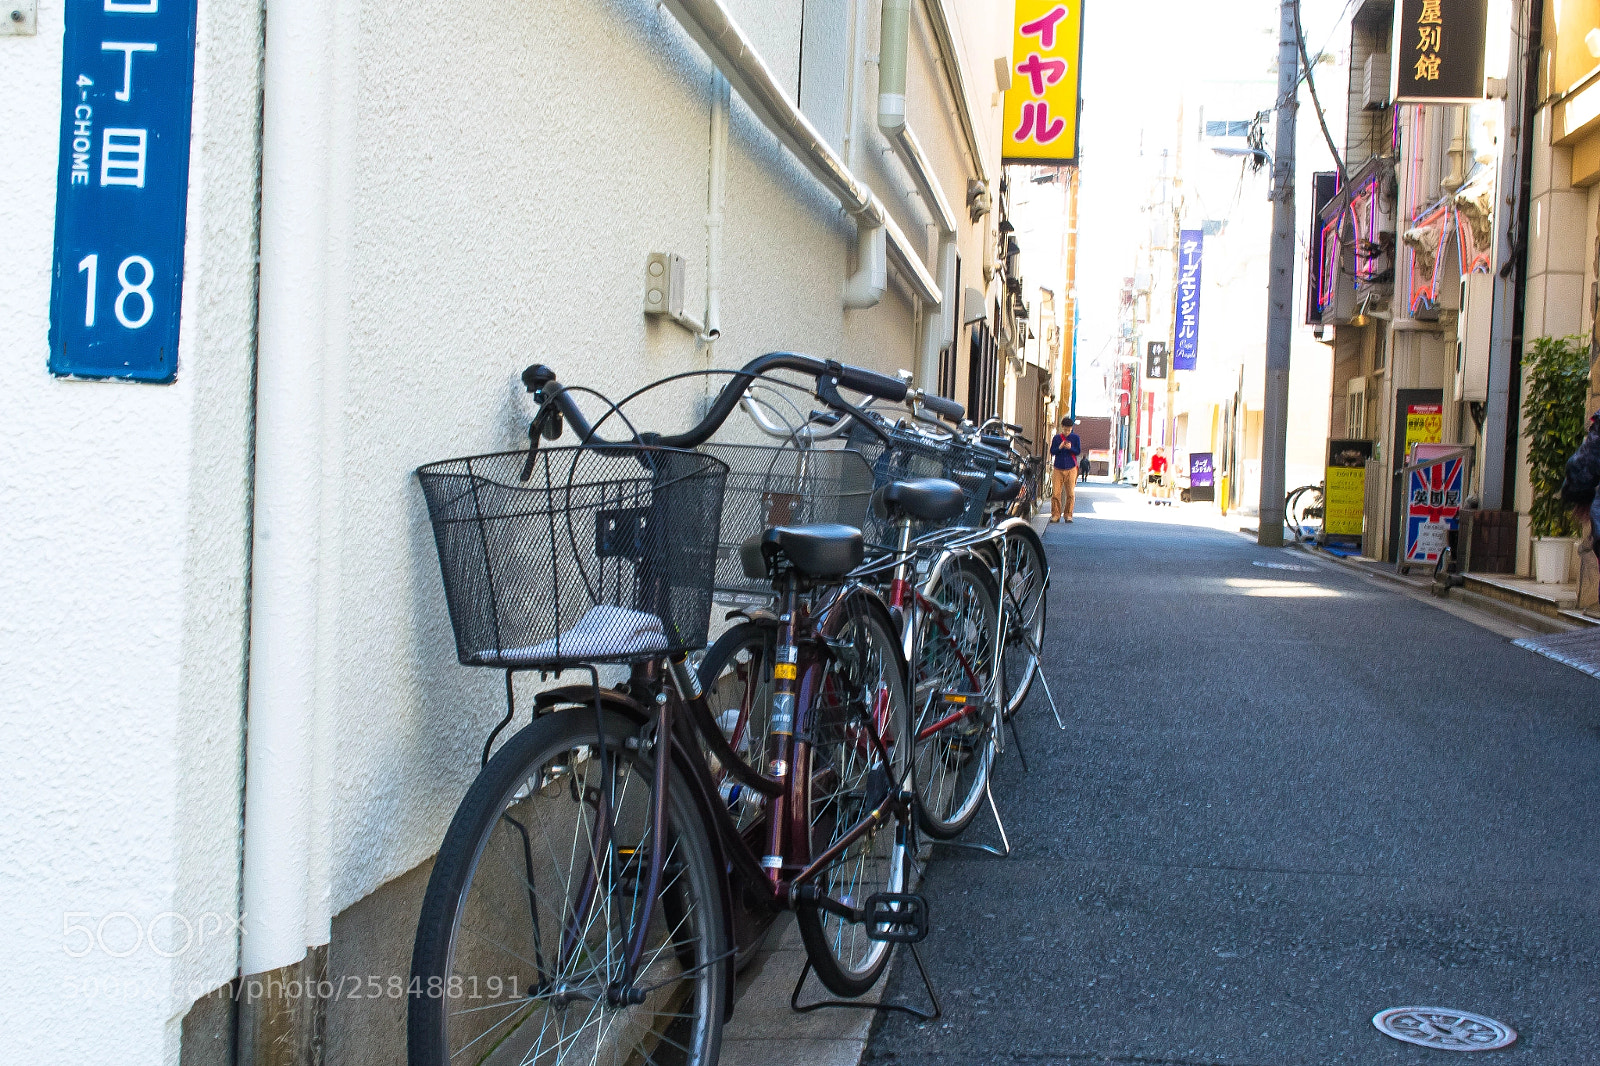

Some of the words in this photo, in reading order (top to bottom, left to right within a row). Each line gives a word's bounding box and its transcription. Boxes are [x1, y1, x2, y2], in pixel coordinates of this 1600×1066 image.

[1014, 5, 1068, 144] イヤル
[1413, 0, 1443, 81] 屋別館
[70, 73, 95, 186] 4-CHOME
[101, 0, 159, 188] 丁目
[77, 253, 155, 330] 18
[1414, 489, 1459, 507] 英国屋
